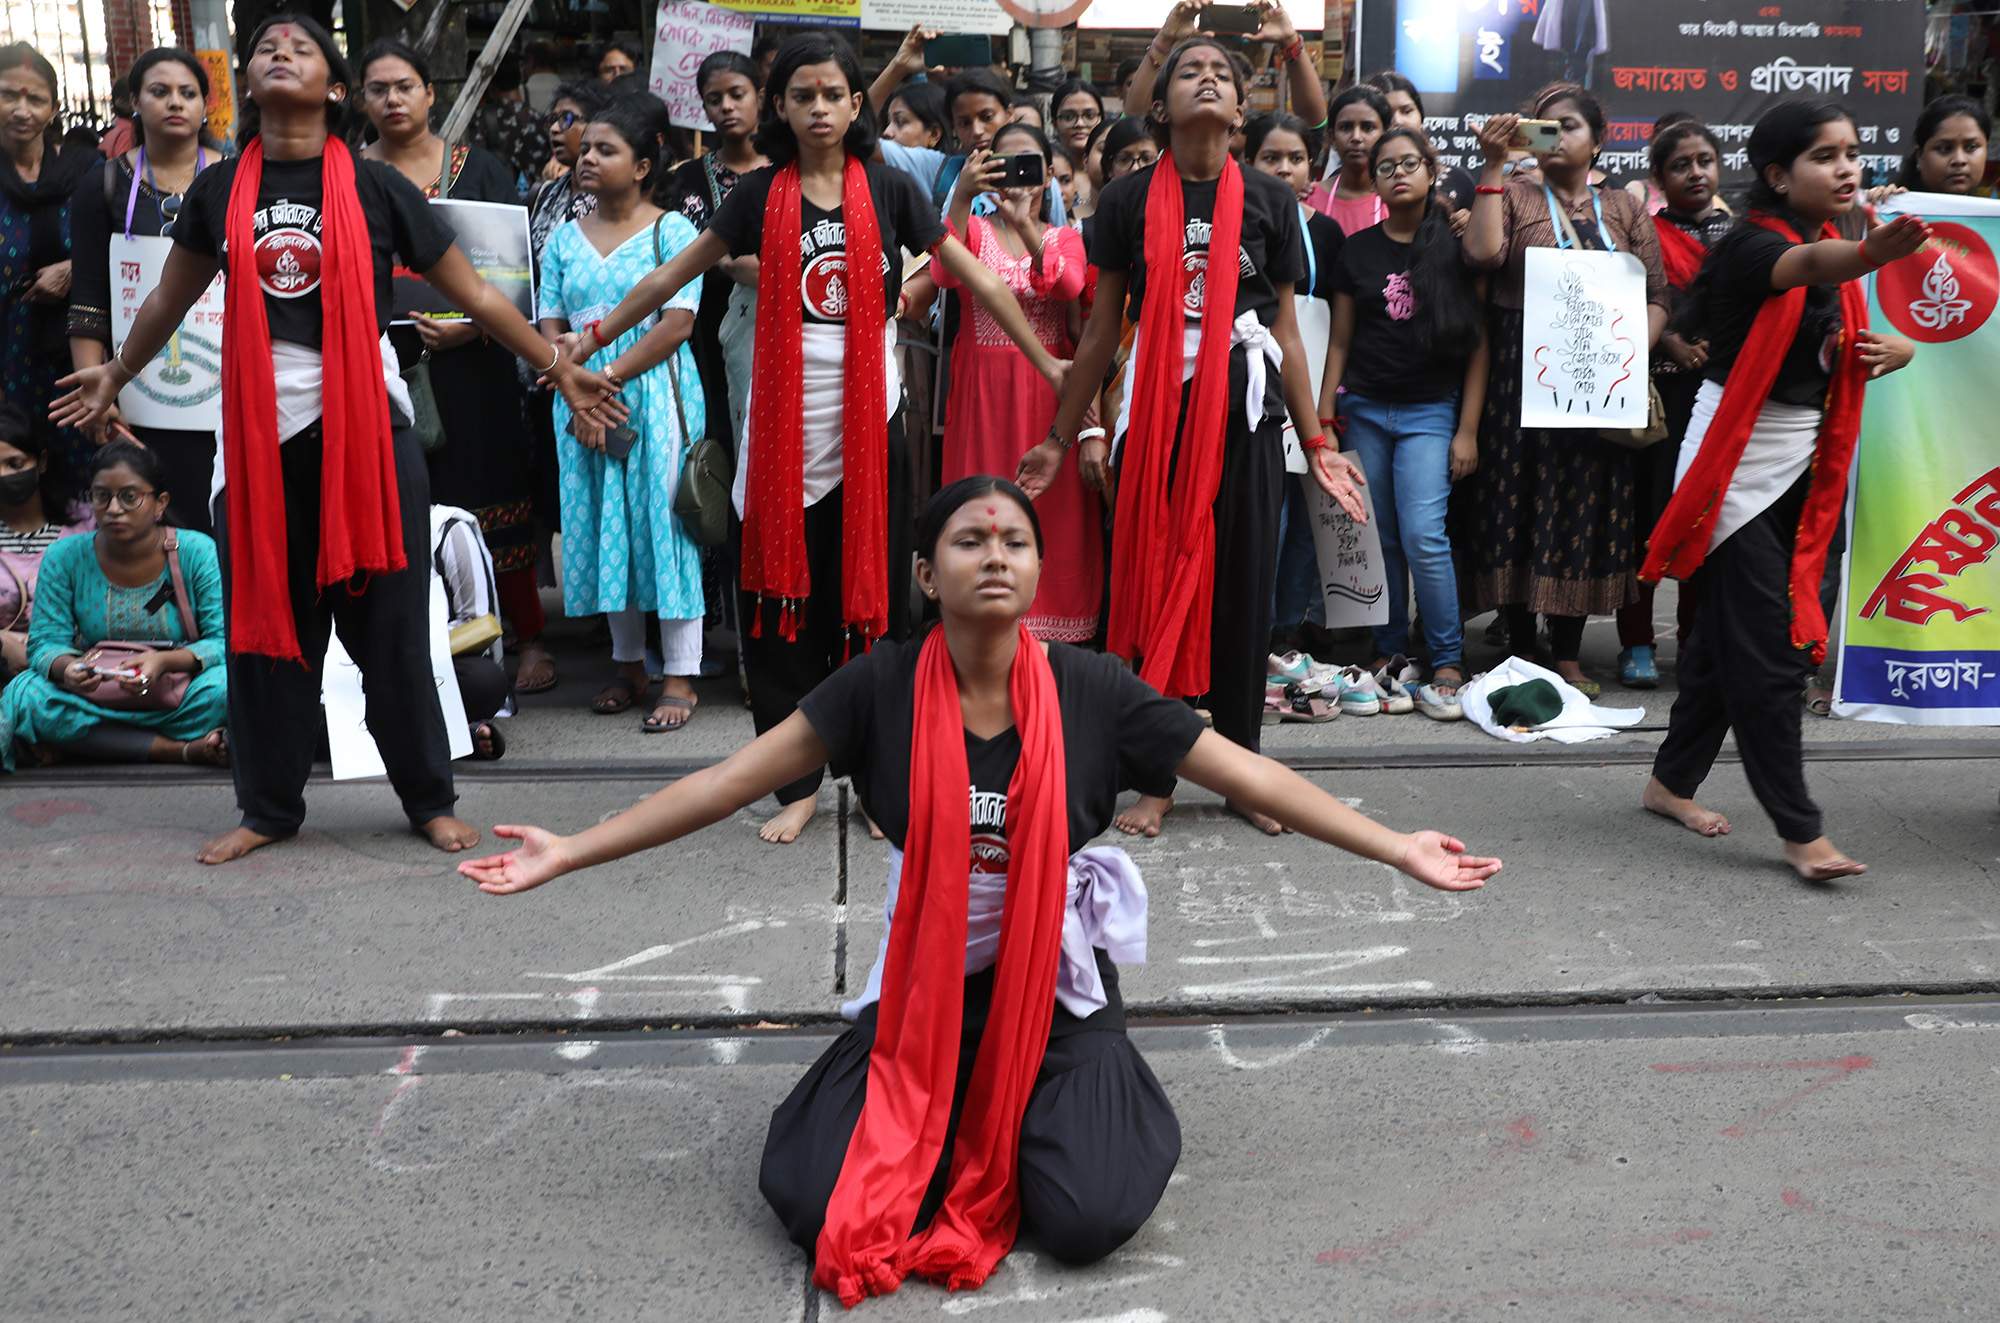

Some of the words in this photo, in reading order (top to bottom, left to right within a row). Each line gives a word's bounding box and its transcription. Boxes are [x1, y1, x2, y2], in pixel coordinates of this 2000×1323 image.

[1611, 66, 1707, 93] জমায়েত
[1719, 69, 1738, 91] ও
[1750, 56, 1853, 95] প্রতিবাদ
[1862, 68, 1909, 94] সভা
